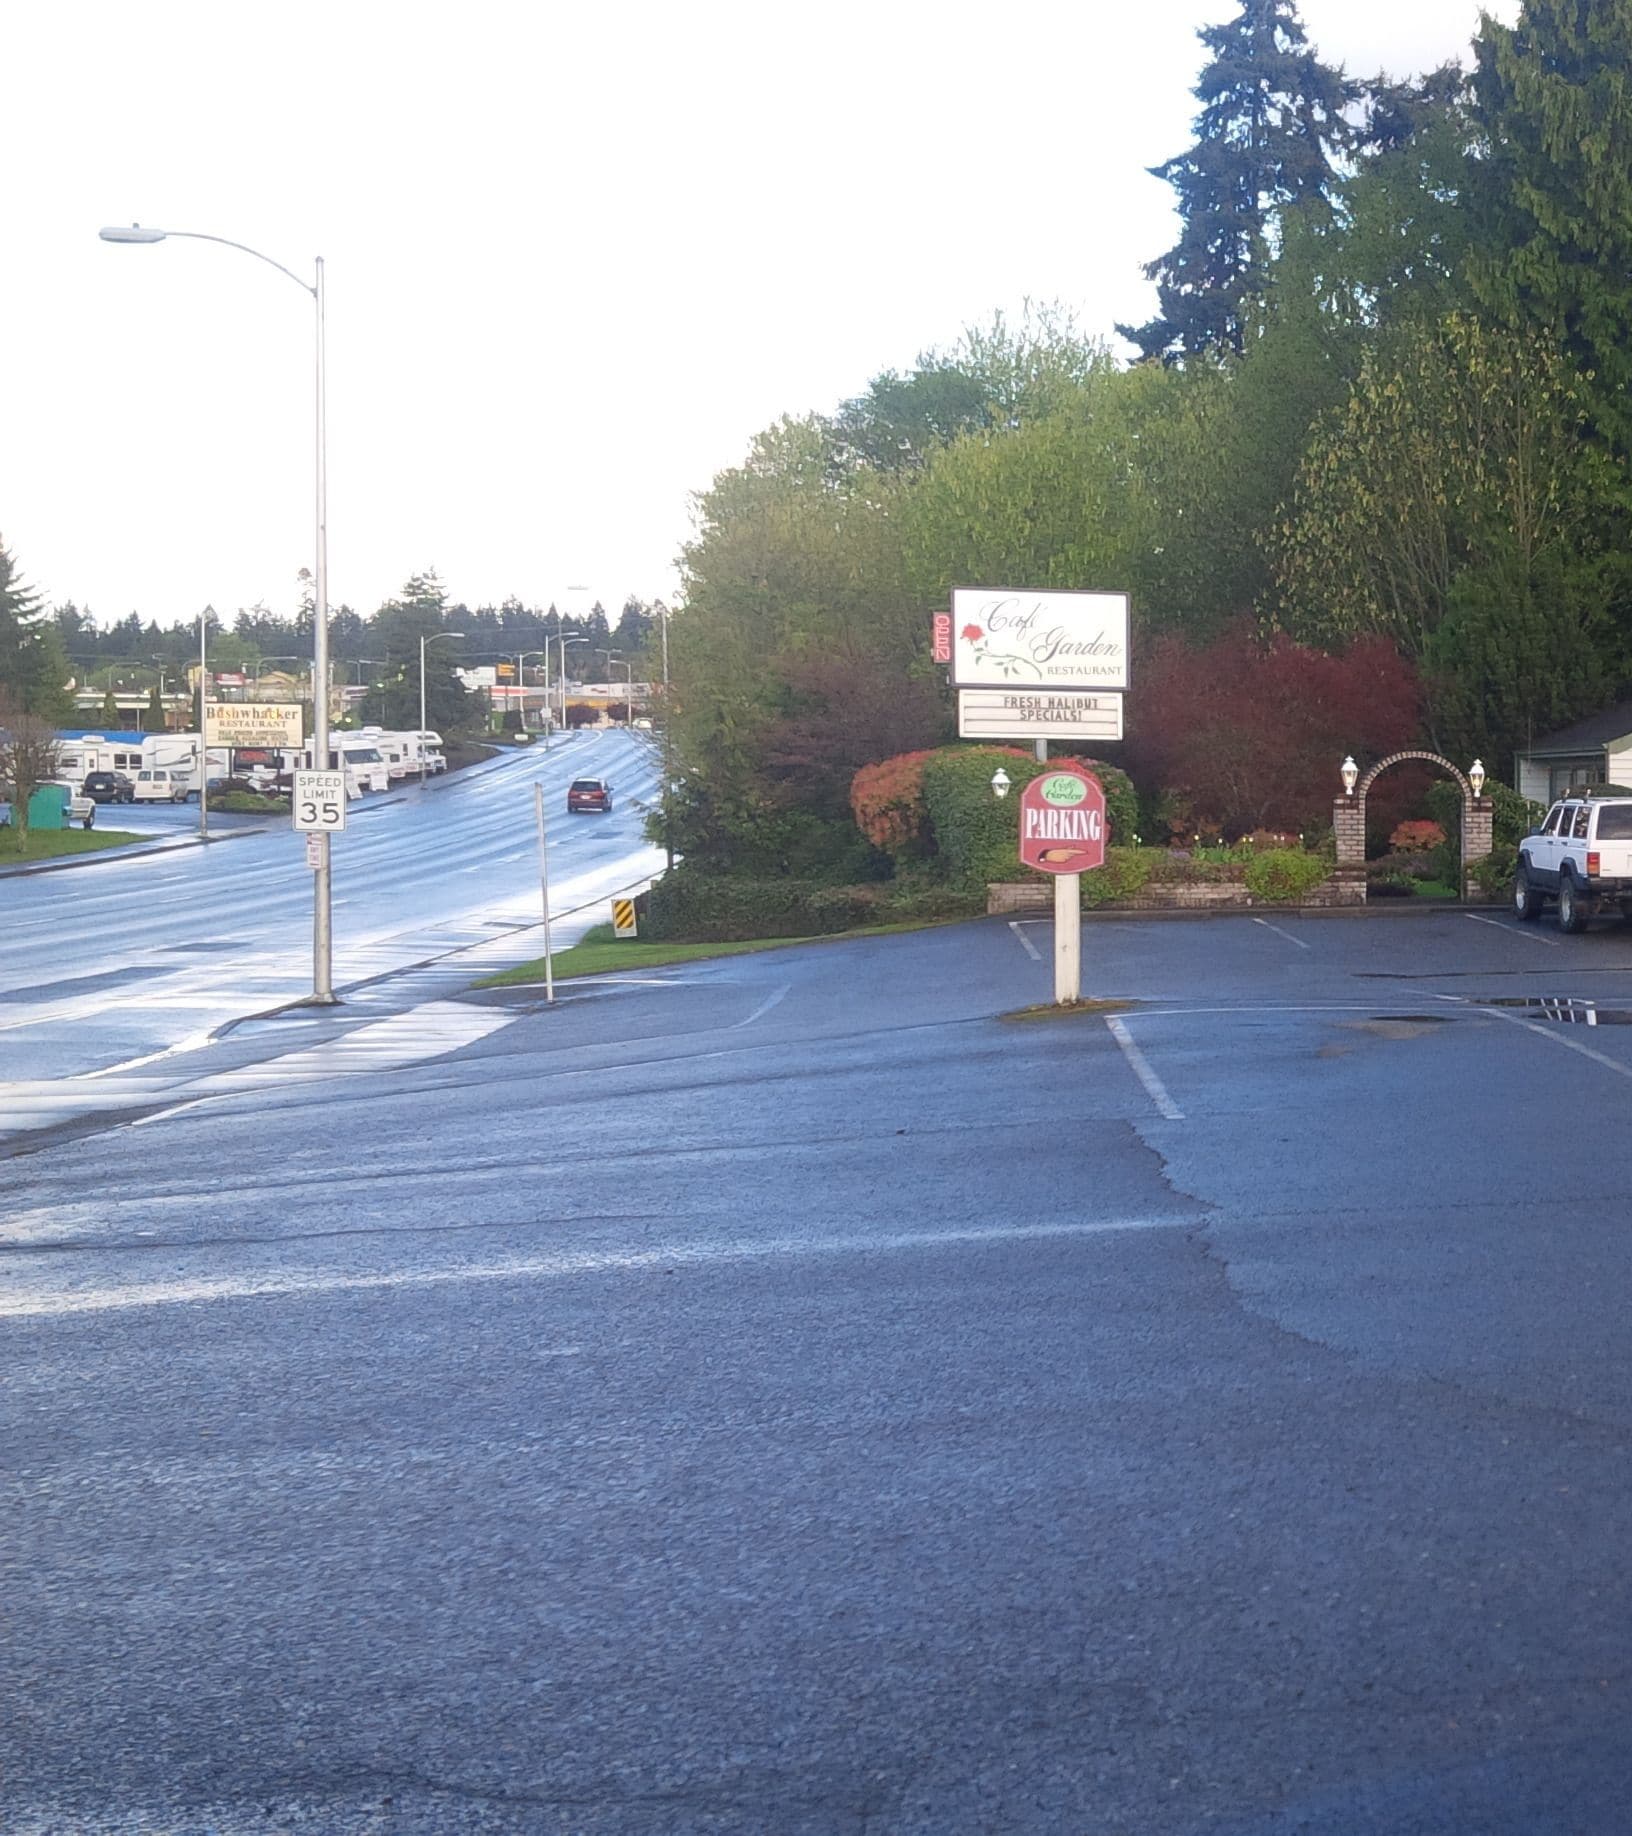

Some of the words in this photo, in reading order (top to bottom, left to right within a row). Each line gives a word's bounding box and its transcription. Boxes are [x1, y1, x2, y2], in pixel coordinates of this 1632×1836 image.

[935, 615, 950, 660] OPEN
[1029, 626, 1121, 662] Garden
[1048, 666, 1122, 675] RESTAURANT
[1004, 697, 1041, 708] FRESH
[1048, 698, 1098, 710] HALIBUT
[206, 707, 298, 719] Bushwhacker
[1020, 709, 1082, 721] SPECIALS!
[219, 720, 287, 728] RESTAURANT
[299, 777, 341, 787] SPEED
[304, 790, 336, 799] LIMIT
[300, 802, 339, 823] 35
[1026, 808, 1101, 840] PARKING
